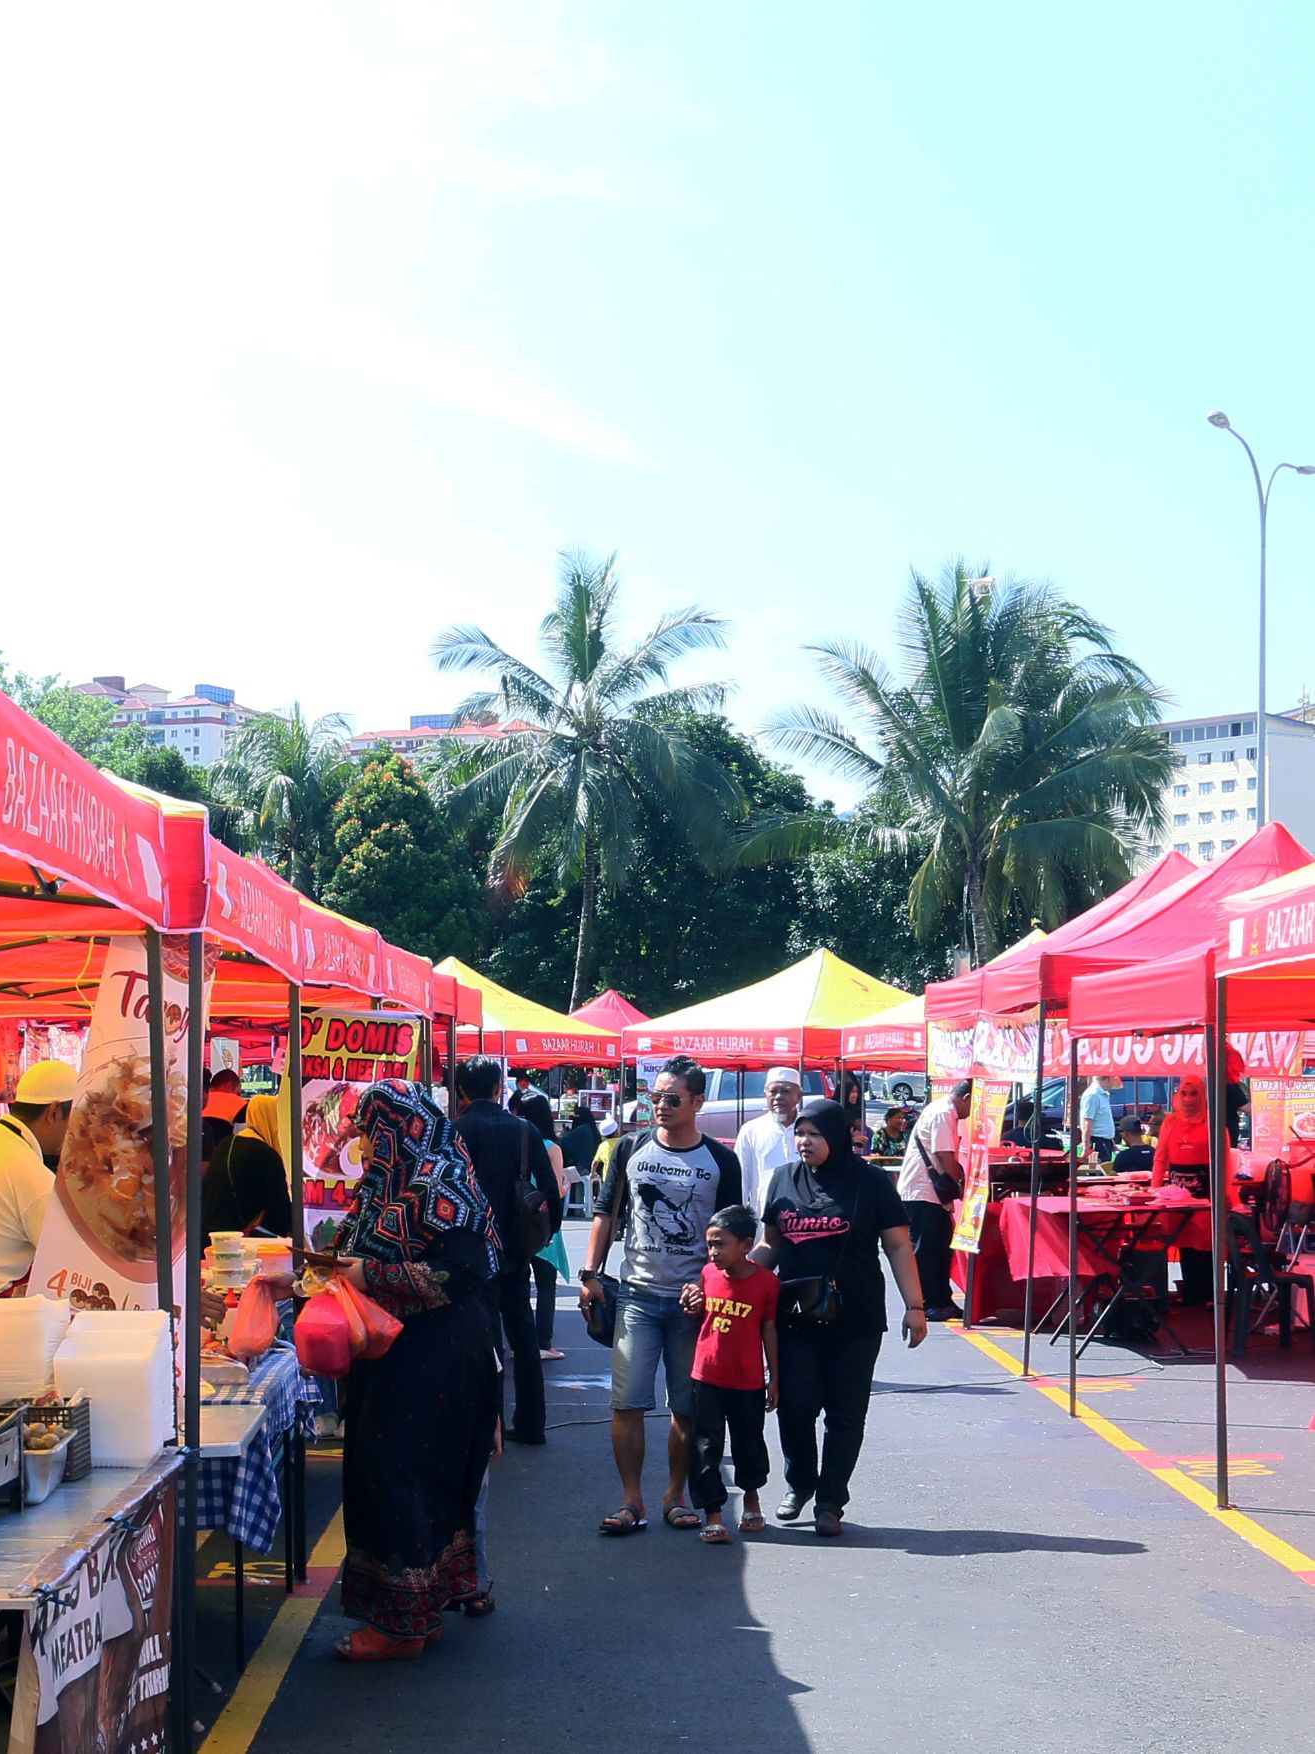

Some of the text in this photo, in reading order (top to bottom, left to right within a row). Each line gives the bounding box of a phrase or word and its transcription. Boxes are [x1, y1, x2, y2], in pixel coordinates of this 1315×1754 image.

[2, 737, 118, 881] BAZAAR HIJRAH
[1265, 901, 1315, 951] BAZAAR
[326, 1018, 414, 1057] DOMIS
[541, 1037, 595, 1053] BAZAAR HIJRAH
[672, 1036, 754, 1051] BAZAAR HIJRAH
[333, 1059, 344, 1080] &
[345, 1059, 374, 1082] MEE
[637, 1160, 711, 1181] Welcome To
[46, 1268, 92, 1298] 4 BIJI
[712, 1317, 732, 1334] FC
